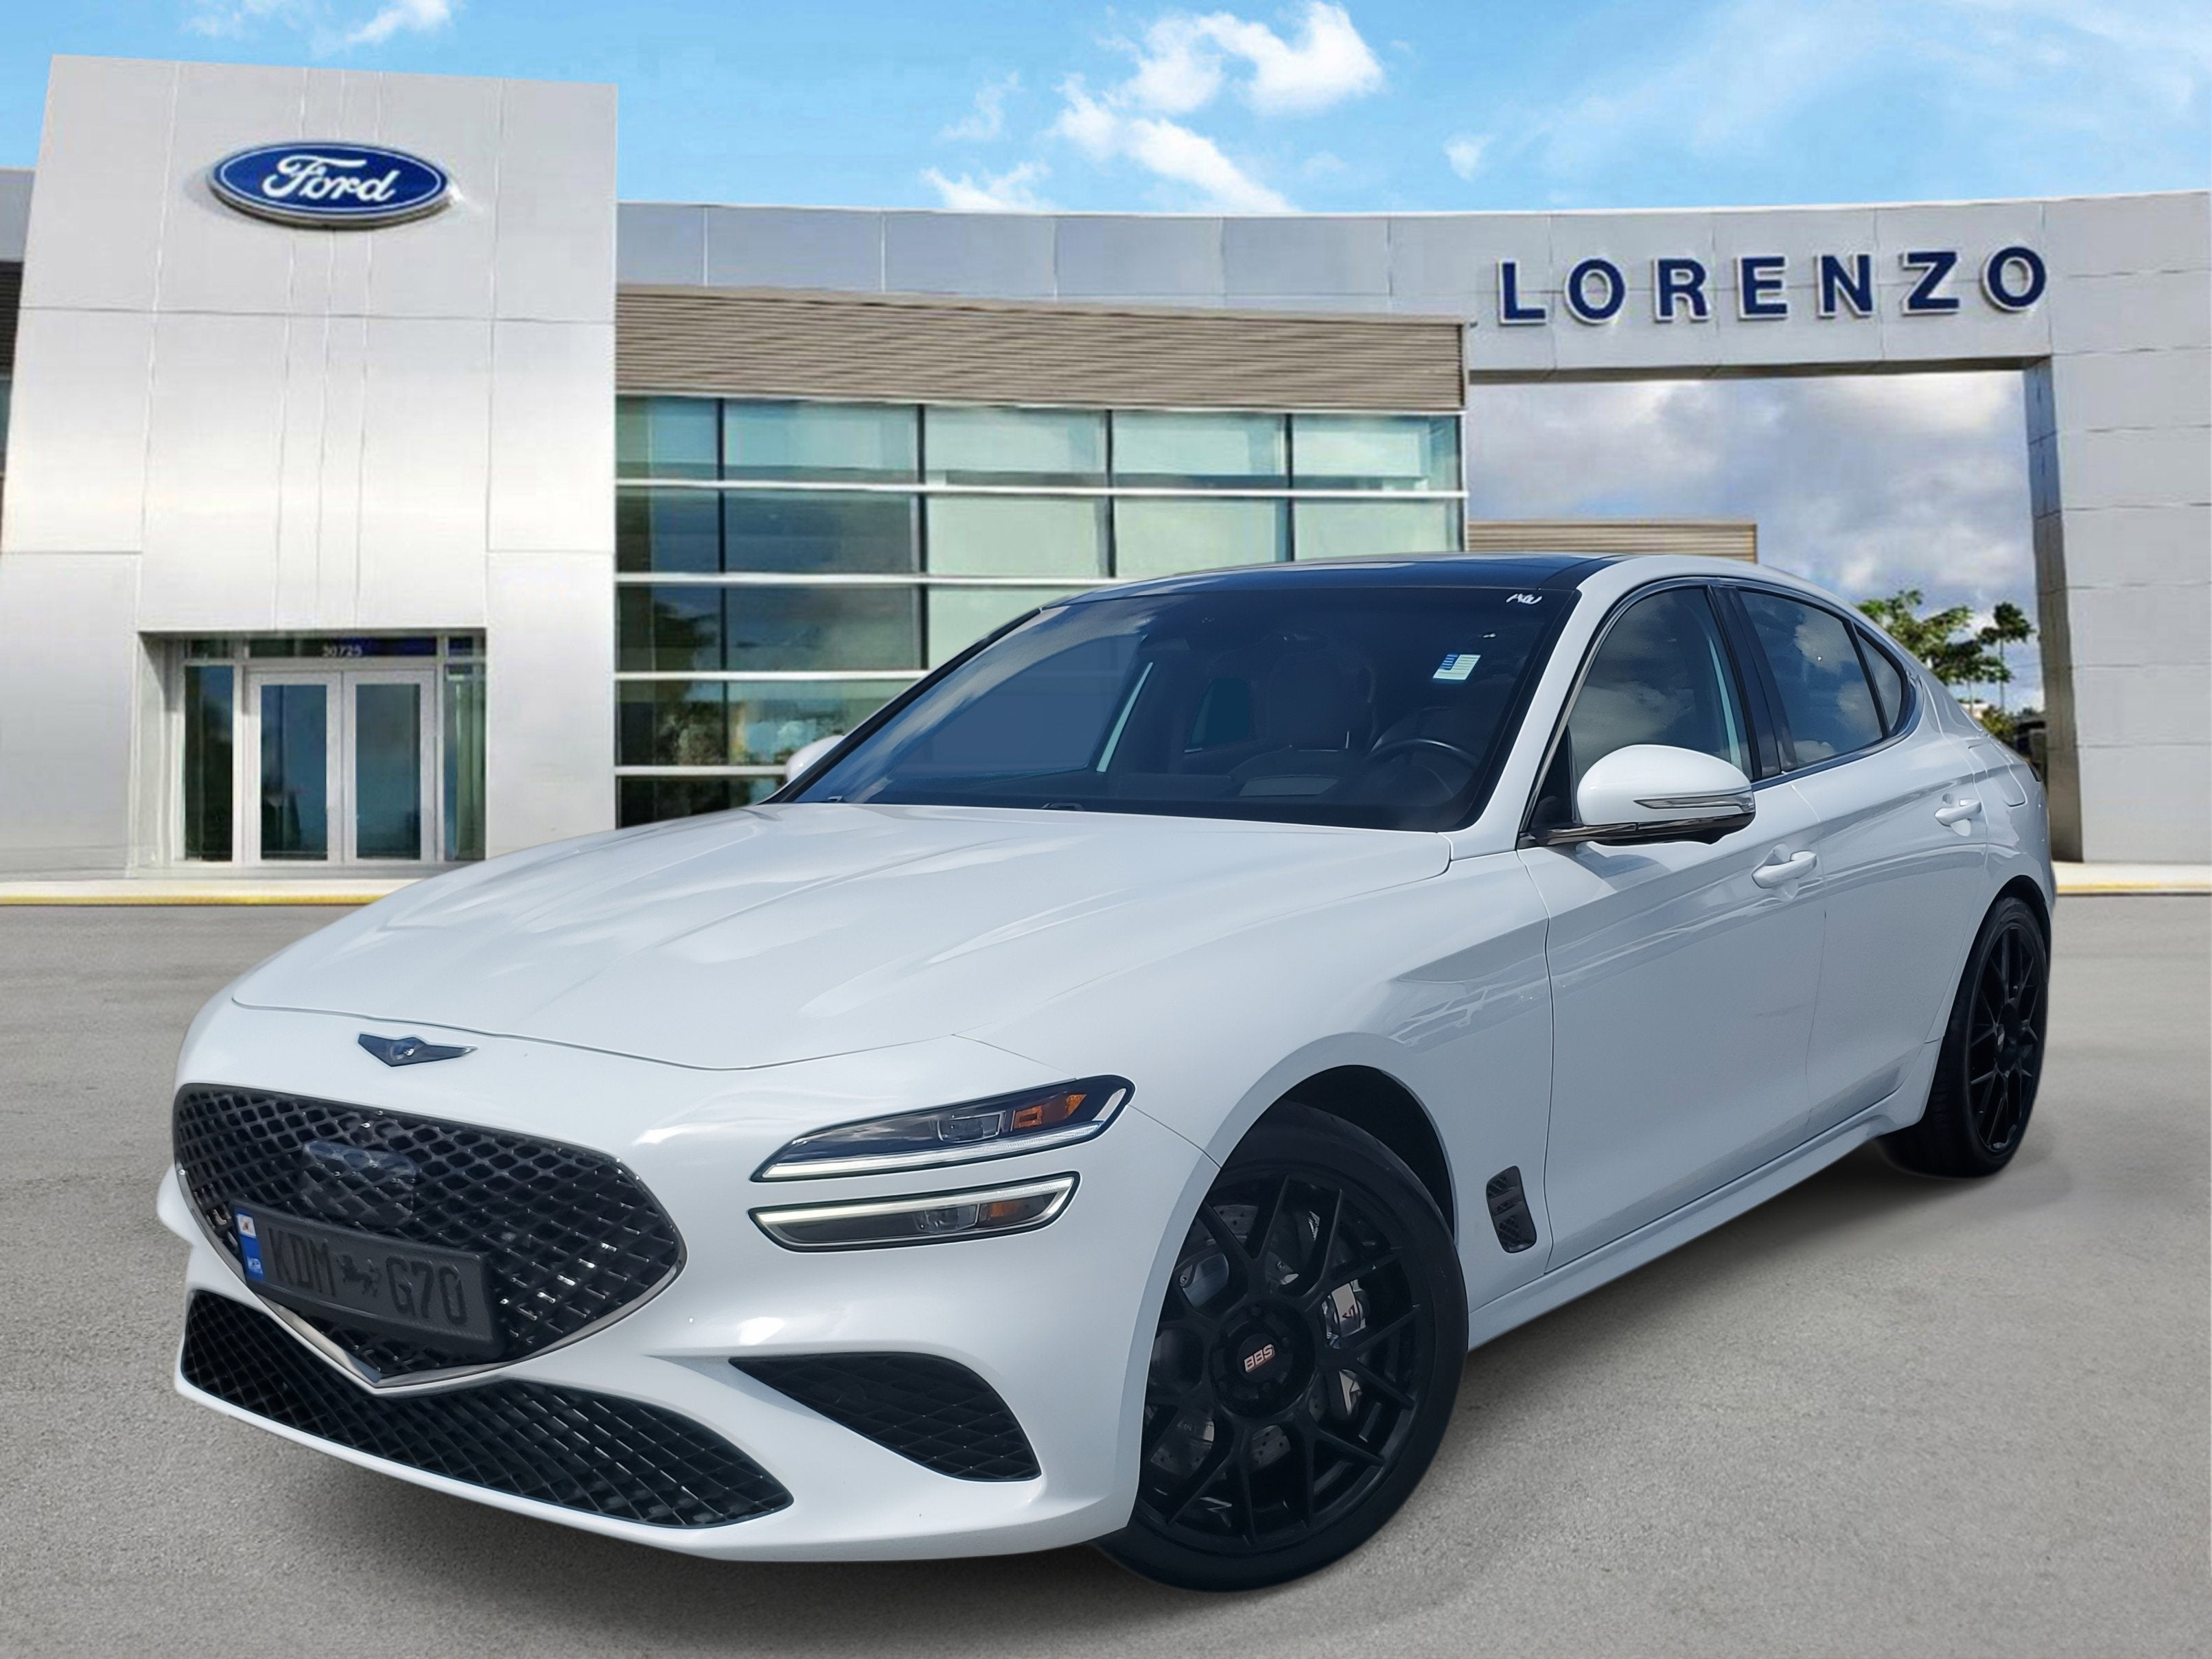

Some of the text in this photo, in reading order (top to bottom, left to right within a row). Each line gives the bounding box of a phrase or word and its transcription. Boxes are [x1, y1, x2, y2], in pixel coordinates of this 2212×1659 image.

[262, 154, 400, 202] Ford
[1499, 246, 2047, 325] LORENZO
[268, 1227, 467, 1325] KDM G70
[1244, 1344, 1275, 1372] BBS
